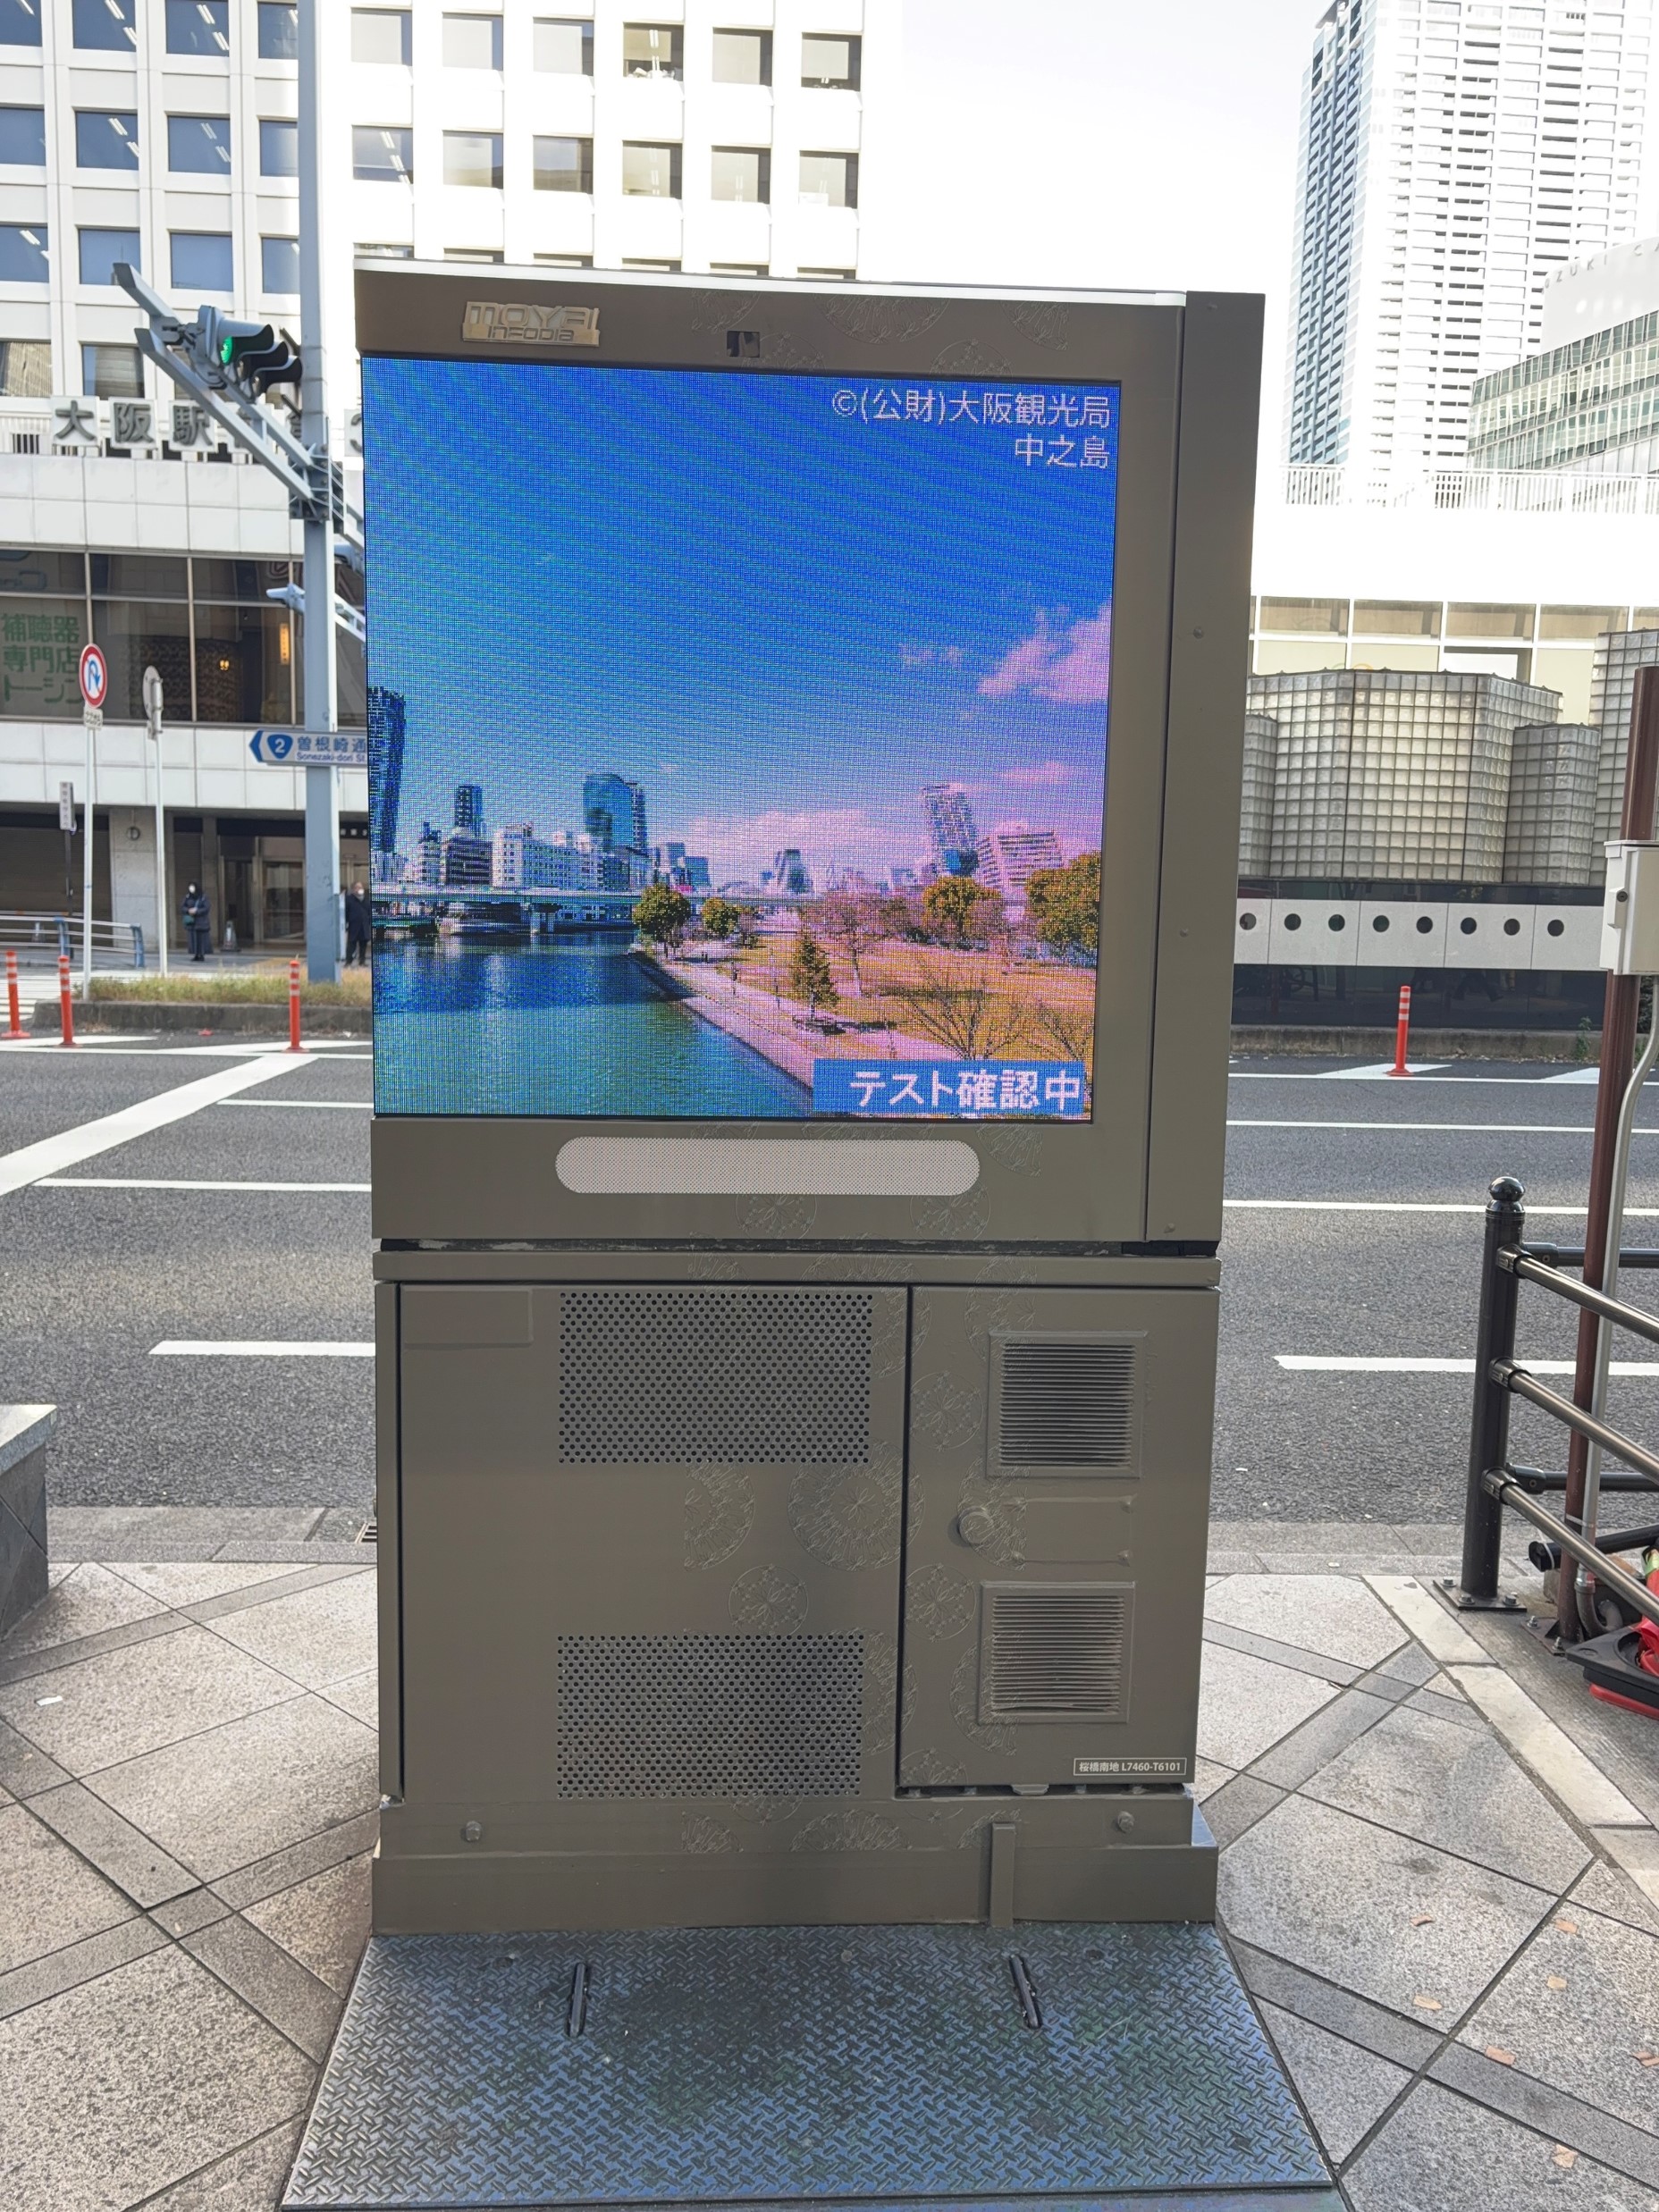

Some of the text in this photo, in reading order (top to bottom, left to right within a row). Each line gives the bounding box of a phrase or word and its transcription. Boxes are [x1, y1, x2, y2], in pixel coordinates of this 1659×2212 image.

[1542, 254, 1607, 292] OZUKI
[1015, 433, 1110, 469] 中之島
[2, 613, 80, 643] 補聴器
[3, 645, 80, 673] 専門店
[274, 737, 286, 753] 2
[850, 1068, 1081, 1111] テスト確認中
[1079, 1762, 1181, 1772] 桜橋南地 L7460-T6101
